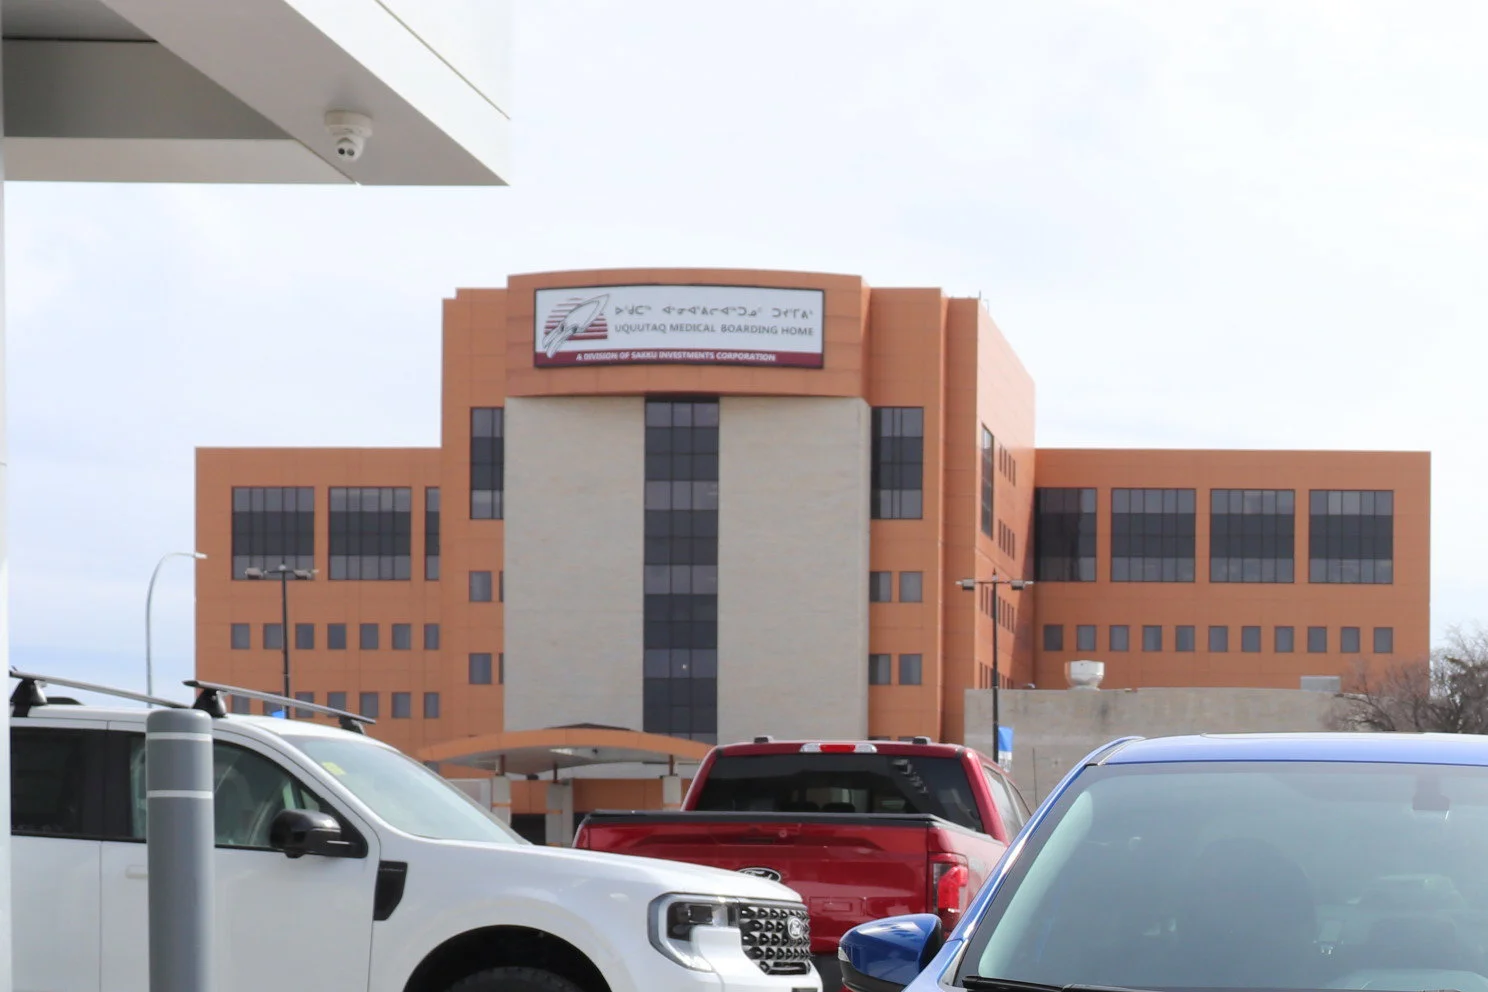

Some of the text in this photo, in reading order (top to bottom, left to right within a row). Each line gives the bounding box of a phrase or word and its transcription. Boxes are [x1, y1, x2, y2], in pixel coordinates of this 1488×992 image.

[615, 323, 814, 336] UQUUTAQ MEDICAL BOARDING HOME
[584, 352, 618, 360] DIVISION
[619, 351, 630, 359] OF
[659, 350, 715, 360] INVESTMENTS
[716, 351, 776, 361] CORPORATION
